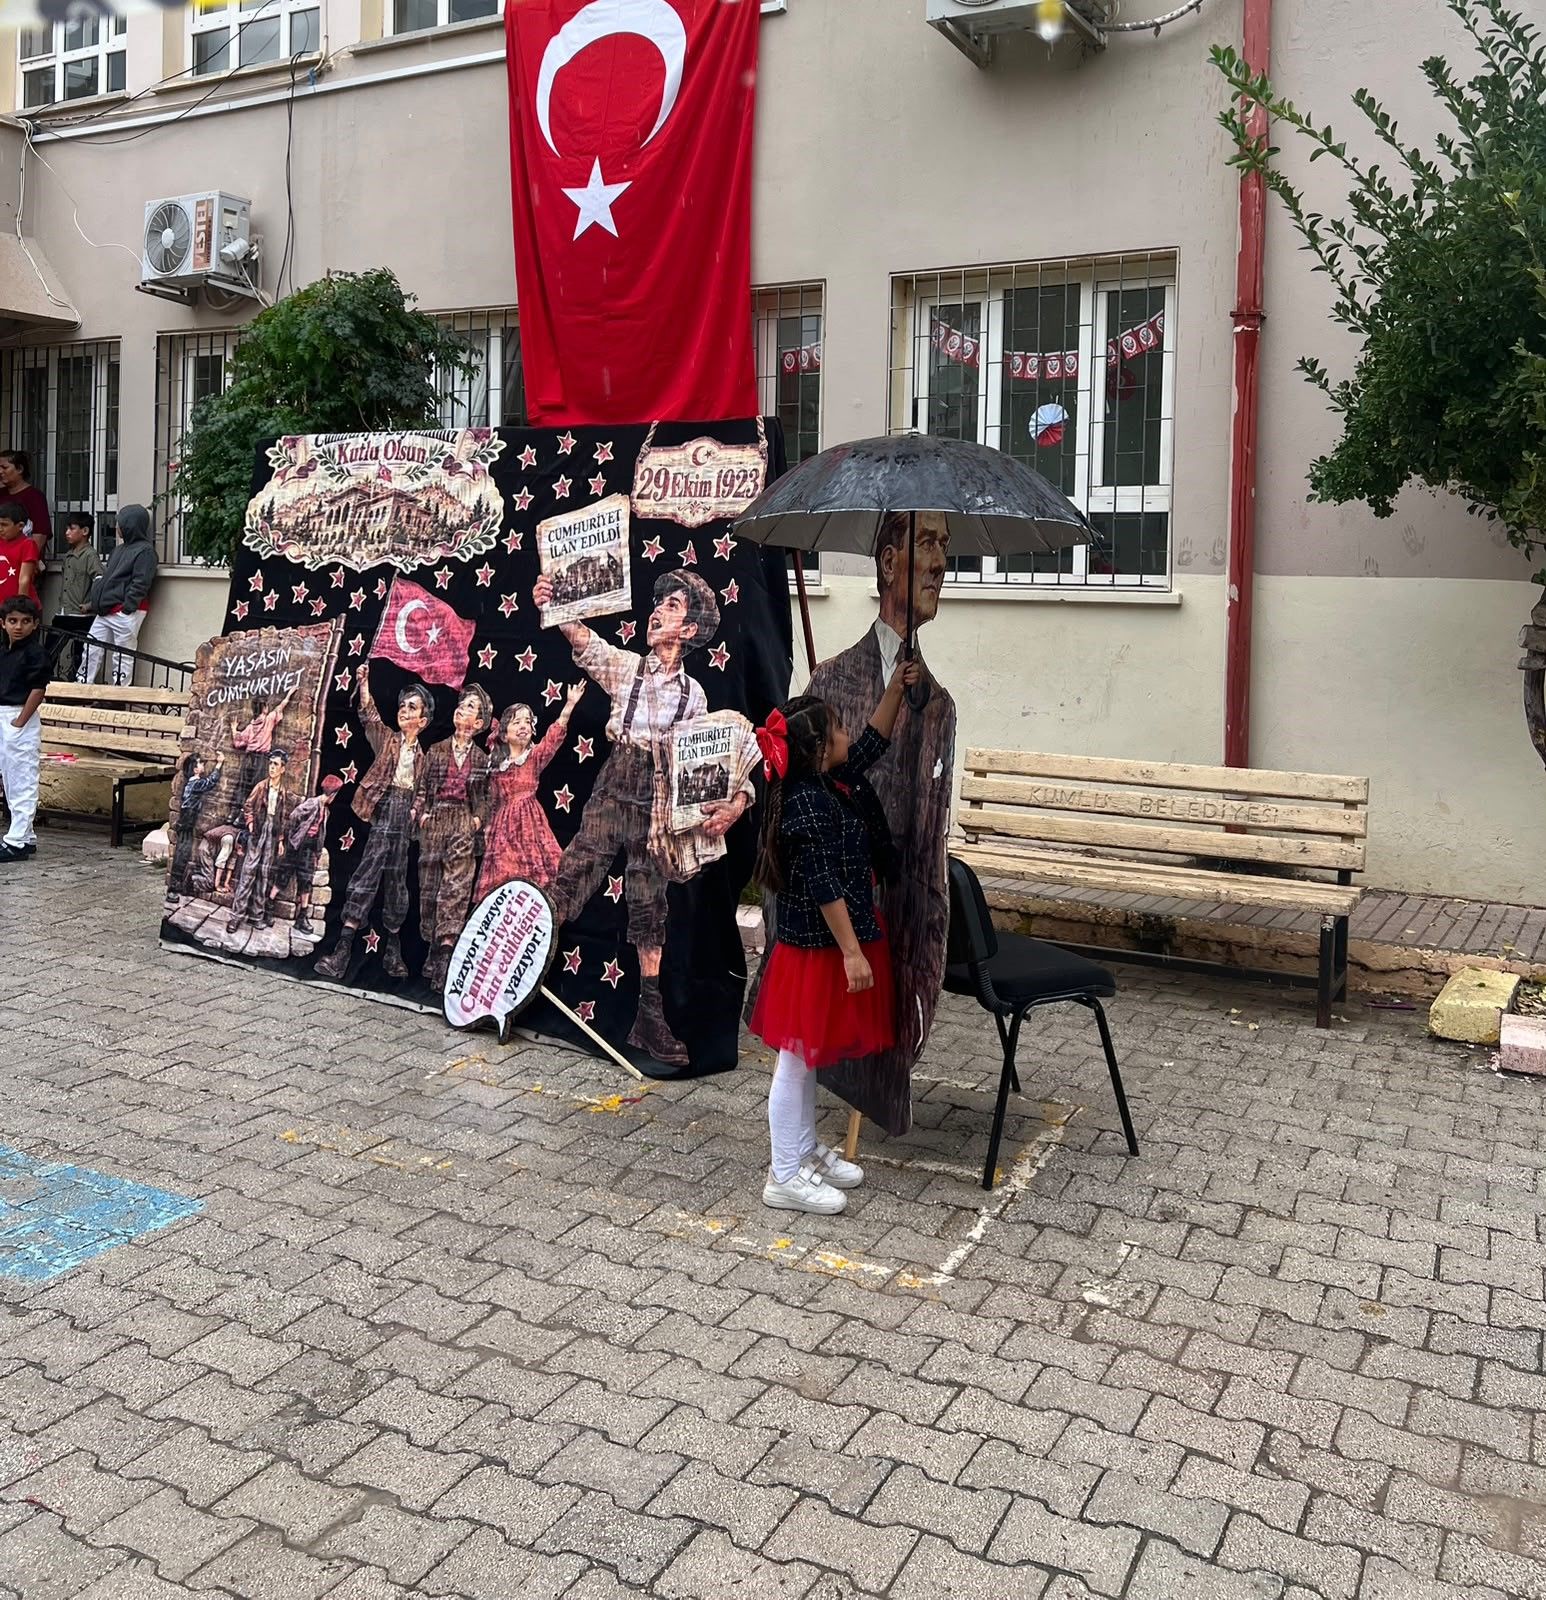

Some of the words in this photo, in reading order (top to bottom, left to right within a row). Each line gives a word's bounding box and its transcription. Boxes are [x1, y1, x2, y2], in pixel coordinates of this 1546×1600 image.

[336, 441, 380, 465] Kutlu
[383, 439, 427, 464] Olsun
[637, 467, 669, 502] 29
[669, 471, 712, 499] Ekim
[713, 467, 760, 499] 1923
[547, 508, 623, 543] CUMHURİYET
[580, 525, 621, 551] EDİLDİ
[225, 646, 292, 678] YAŞASIN
[206, 668, 305, 707] CUMHURİYET
[678, 726, 733, 747] CUMHURİYET
[701, 739, 731, 757] EDİLDİ
[448, 938, 480, 997] Yazıyor
[460, 889, 530, 1013] Cumhuriyet'in
[480, 976, 503, 1011] ilan
[499, 898, 544, 975] edildiğini
[504, 925, 546, 1000] yazıyor!
